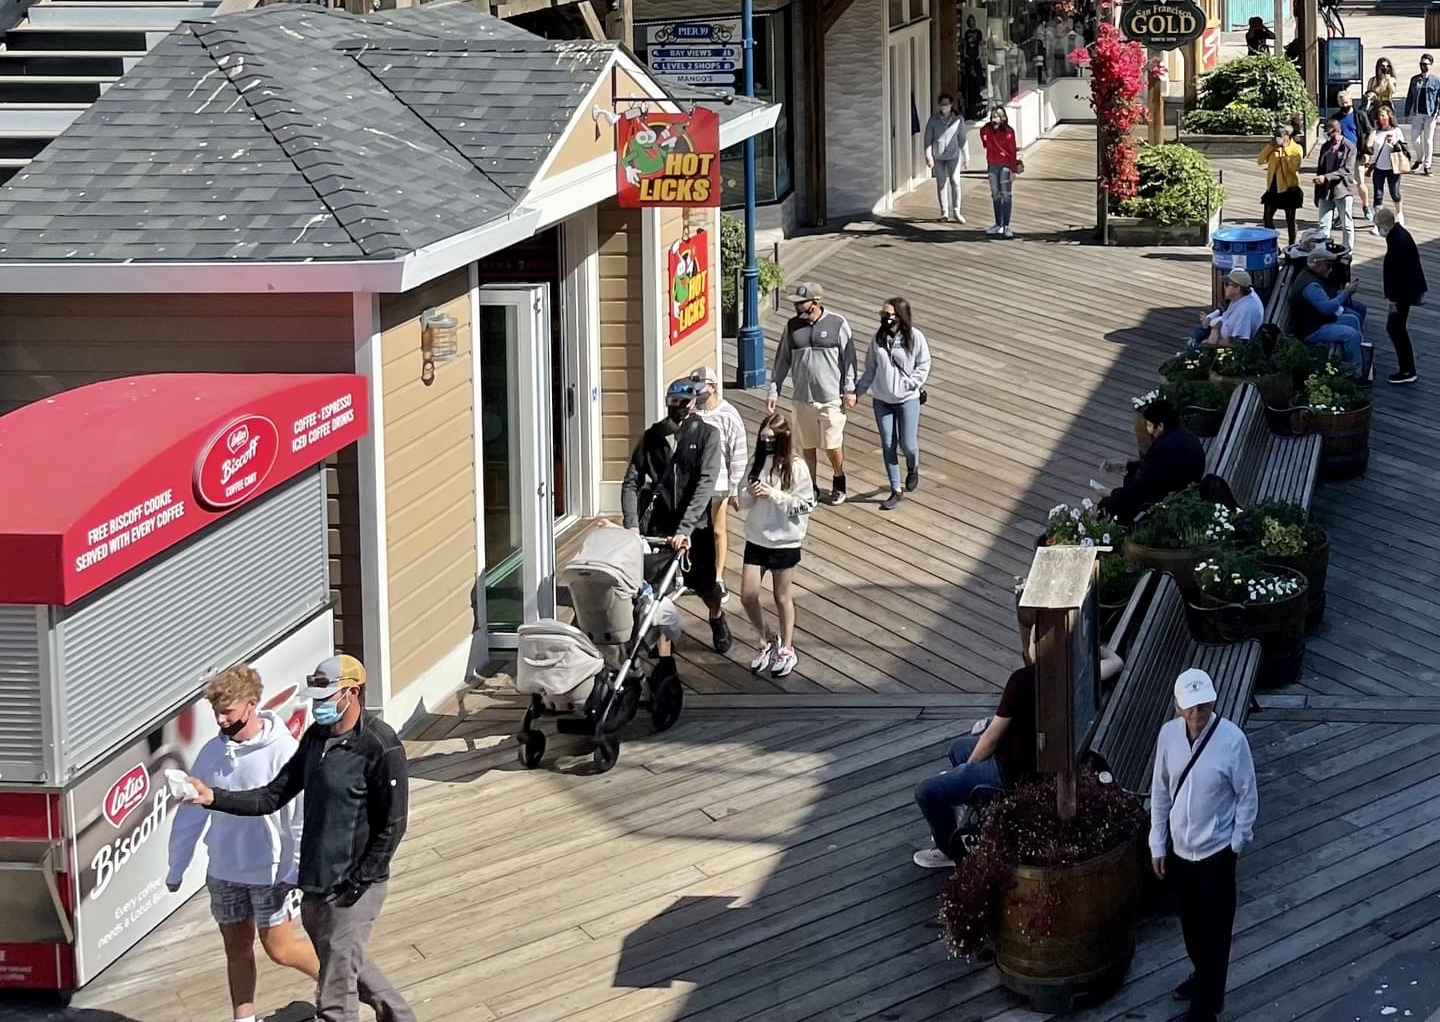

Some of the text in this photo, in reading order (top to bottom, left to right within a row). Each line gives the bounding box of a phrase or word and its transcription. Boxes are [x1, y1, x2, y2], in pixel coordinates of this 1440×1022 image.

[1130, 15, 1197, 34] GOLD
[1135, 5, 1192, 19] San Francisco
[678, 27, 709, 36] PIER 39
[662, 62, 685, 70] LEVEL
[670, 49, 712, 57] BAY VIEWS
[664, 152, 715, 177] HOT
[639, 177, 711, 202] LICKS
[688, 269, 707, 299] HOT
[679, 296, 706, 332] LICKS
[294, 393, 352, 435] COFFEE ESPRESSO
[292, 409, 355, 453] ICED COFFEE DRINKS
[220, 435, 261, 486] Biscoff
[225, 471, 257, 497] COFFEE CART
[88, 488, 173, 546] FREE BISCOFF COOKIE
[75, 500, 185, 572] SERVED WITH EVERY COFFEE
[90, 785, 172, 900] Biscoff
